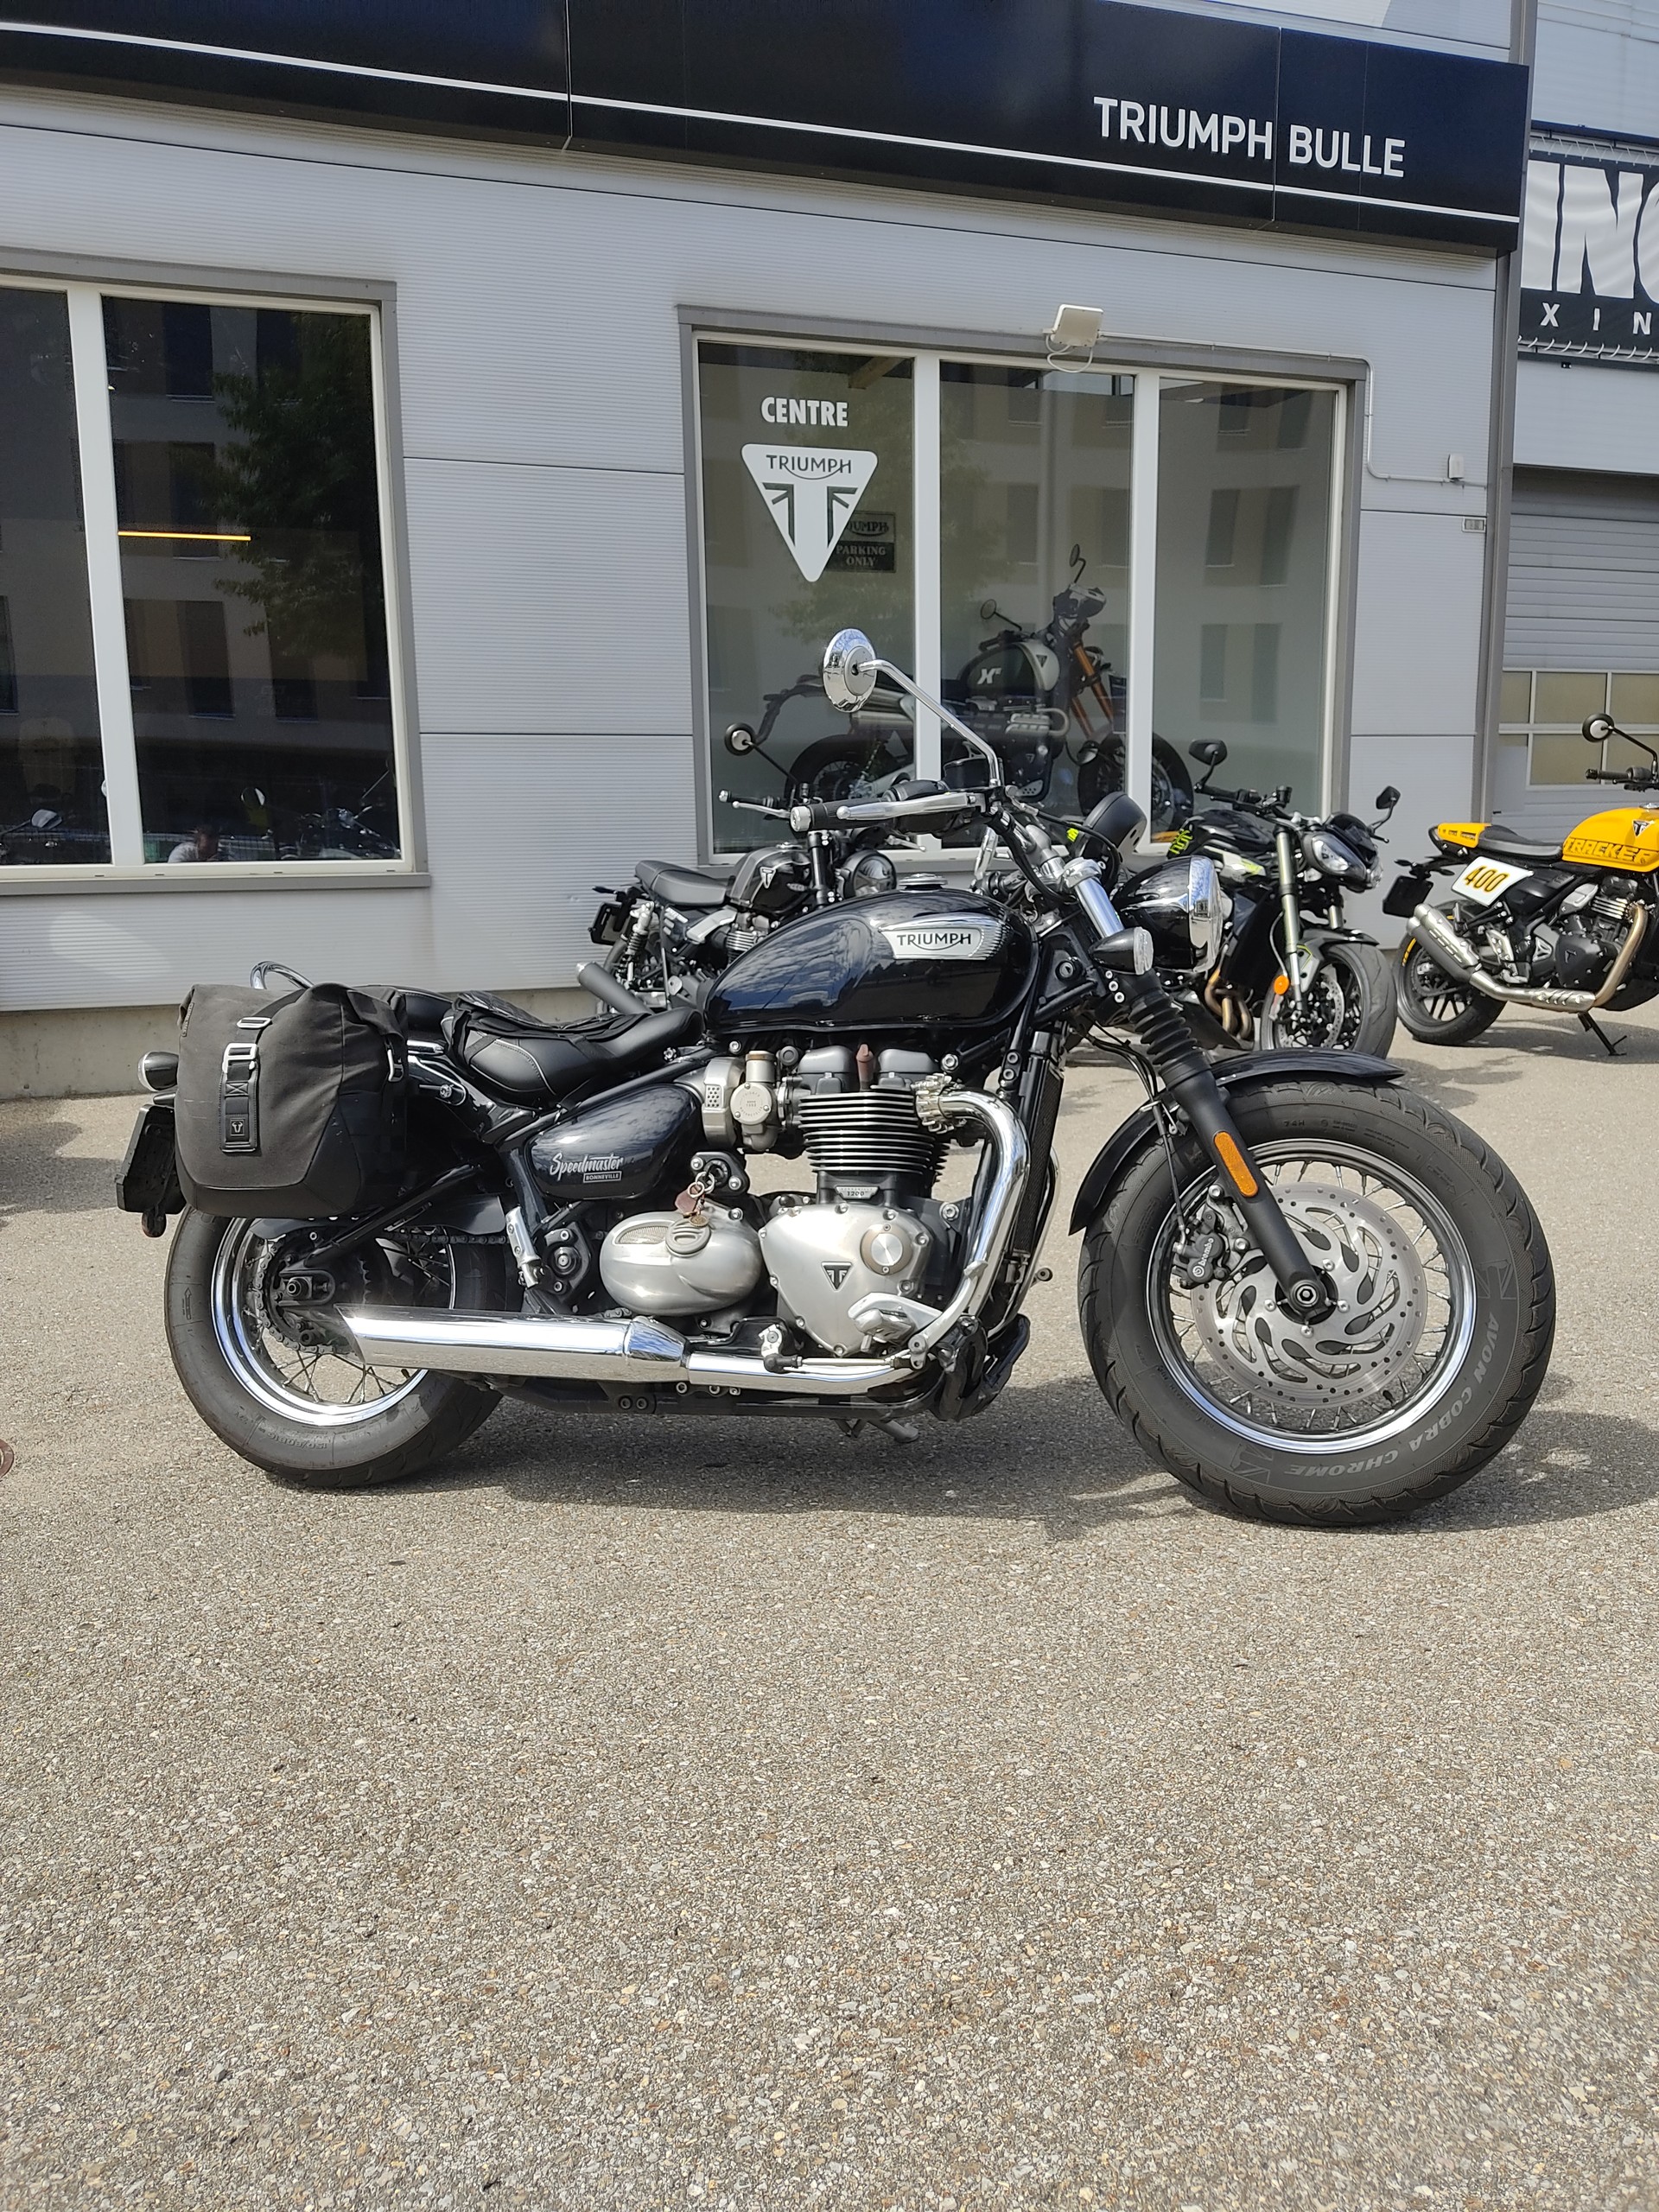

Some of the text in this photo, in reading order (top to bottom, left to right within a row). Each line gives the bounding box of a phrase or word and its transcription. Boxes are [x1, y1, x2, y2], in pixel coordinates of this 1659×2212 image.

[1093, 96, 1406, 178] TRIUMPH BULLE
[760, 397, 849, 427] CENTRE
[766, 454, 852, 475] TRIUMPH
[836, 544, 887, 556] PARKING
[846, 556, 876, 567] ONLY
[1464, 866, 1510, 893] 400
[896, 932, 972, 947] TRIUMPH
[550, 1152, 624, 1182] Speedmaster
[1198, 1237, 1215, 1268] brembo
[1284, 1312, 1500, 1478] AVON COBRA CHROME
